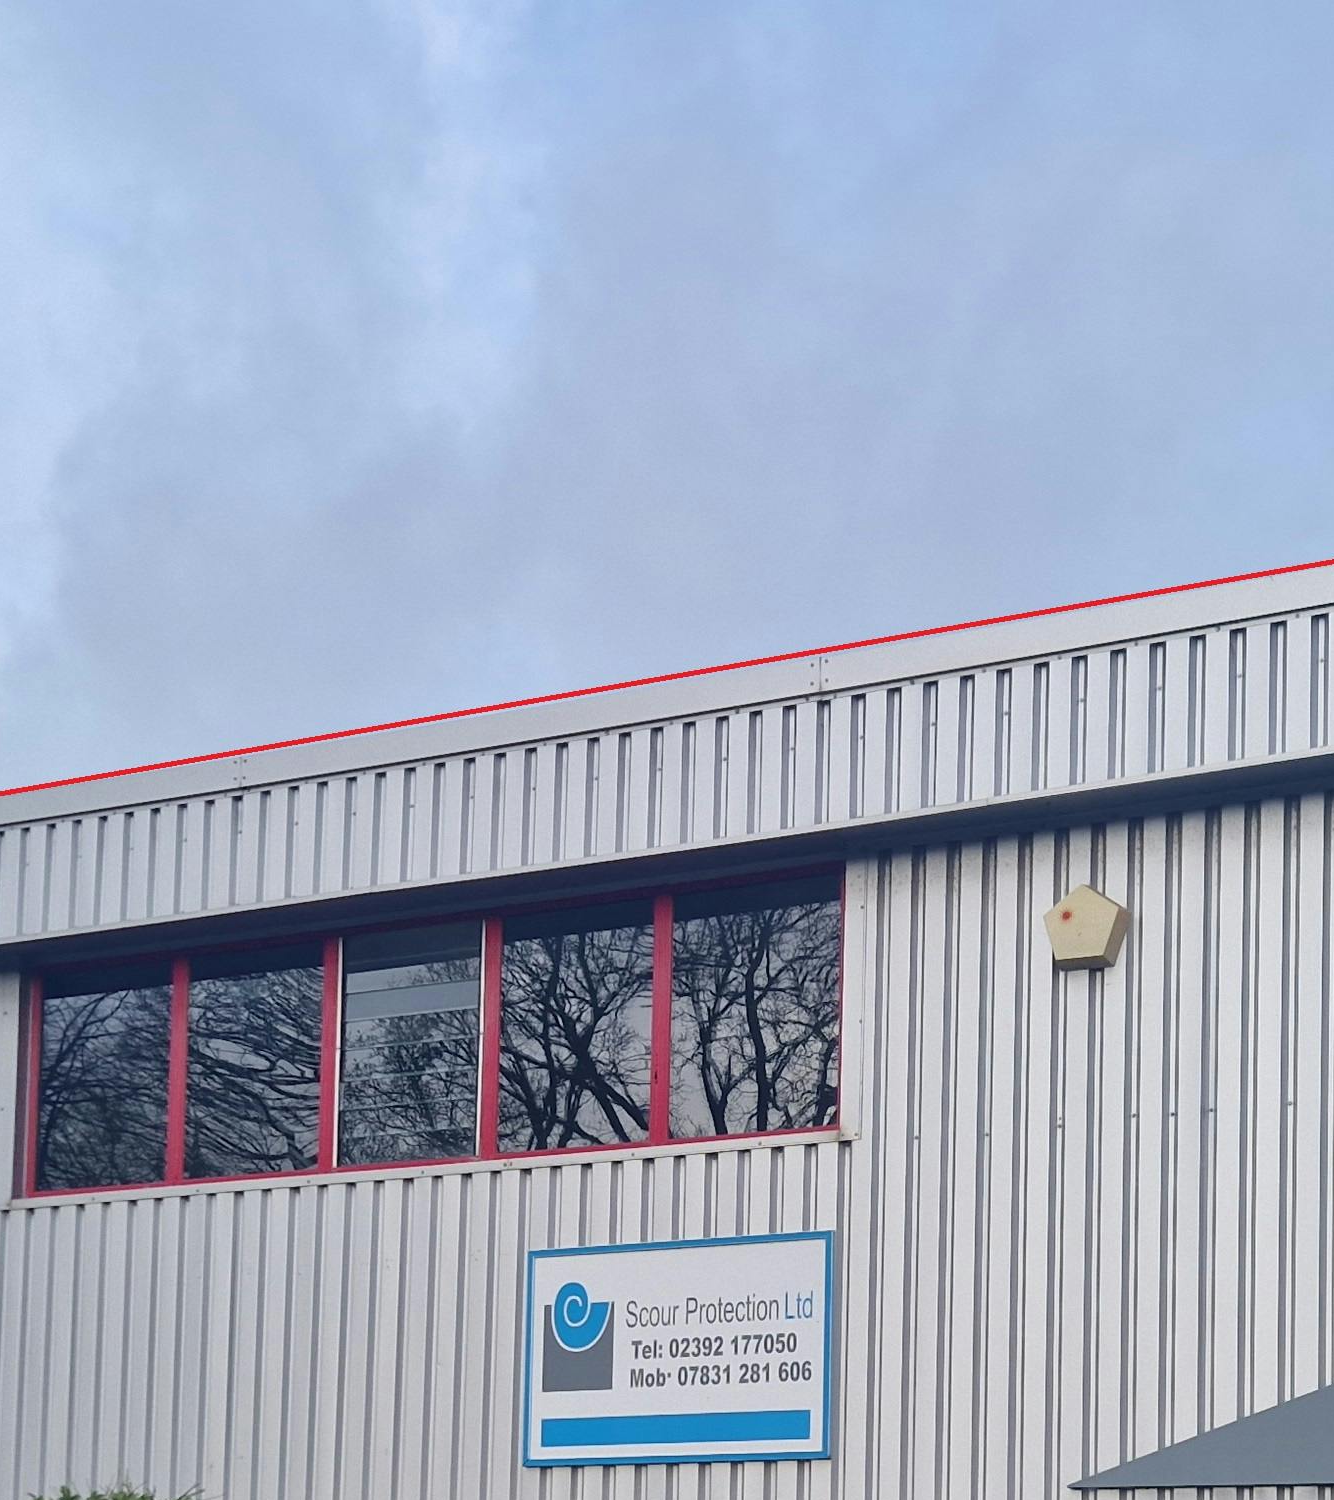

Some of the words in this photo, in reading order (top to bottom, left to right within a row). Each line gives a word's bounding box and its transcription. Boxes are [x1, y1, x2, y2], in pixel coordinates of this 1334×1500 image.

[625, 1300, 680, 1329] Scour
[685, 1293, 780, 1325] Protection
[784, 1290, 814, 1320] Ltd
[631, 1339, 663, 1360] Tel:
[669, 1336, 724, 1358] 02392
[730, 1332, 798, 1355] 177050
[677, 1364, 731, 1386] 07831
[738, 1362, 771, 1384] 281
[778, 1360, 812, 1382] 606
